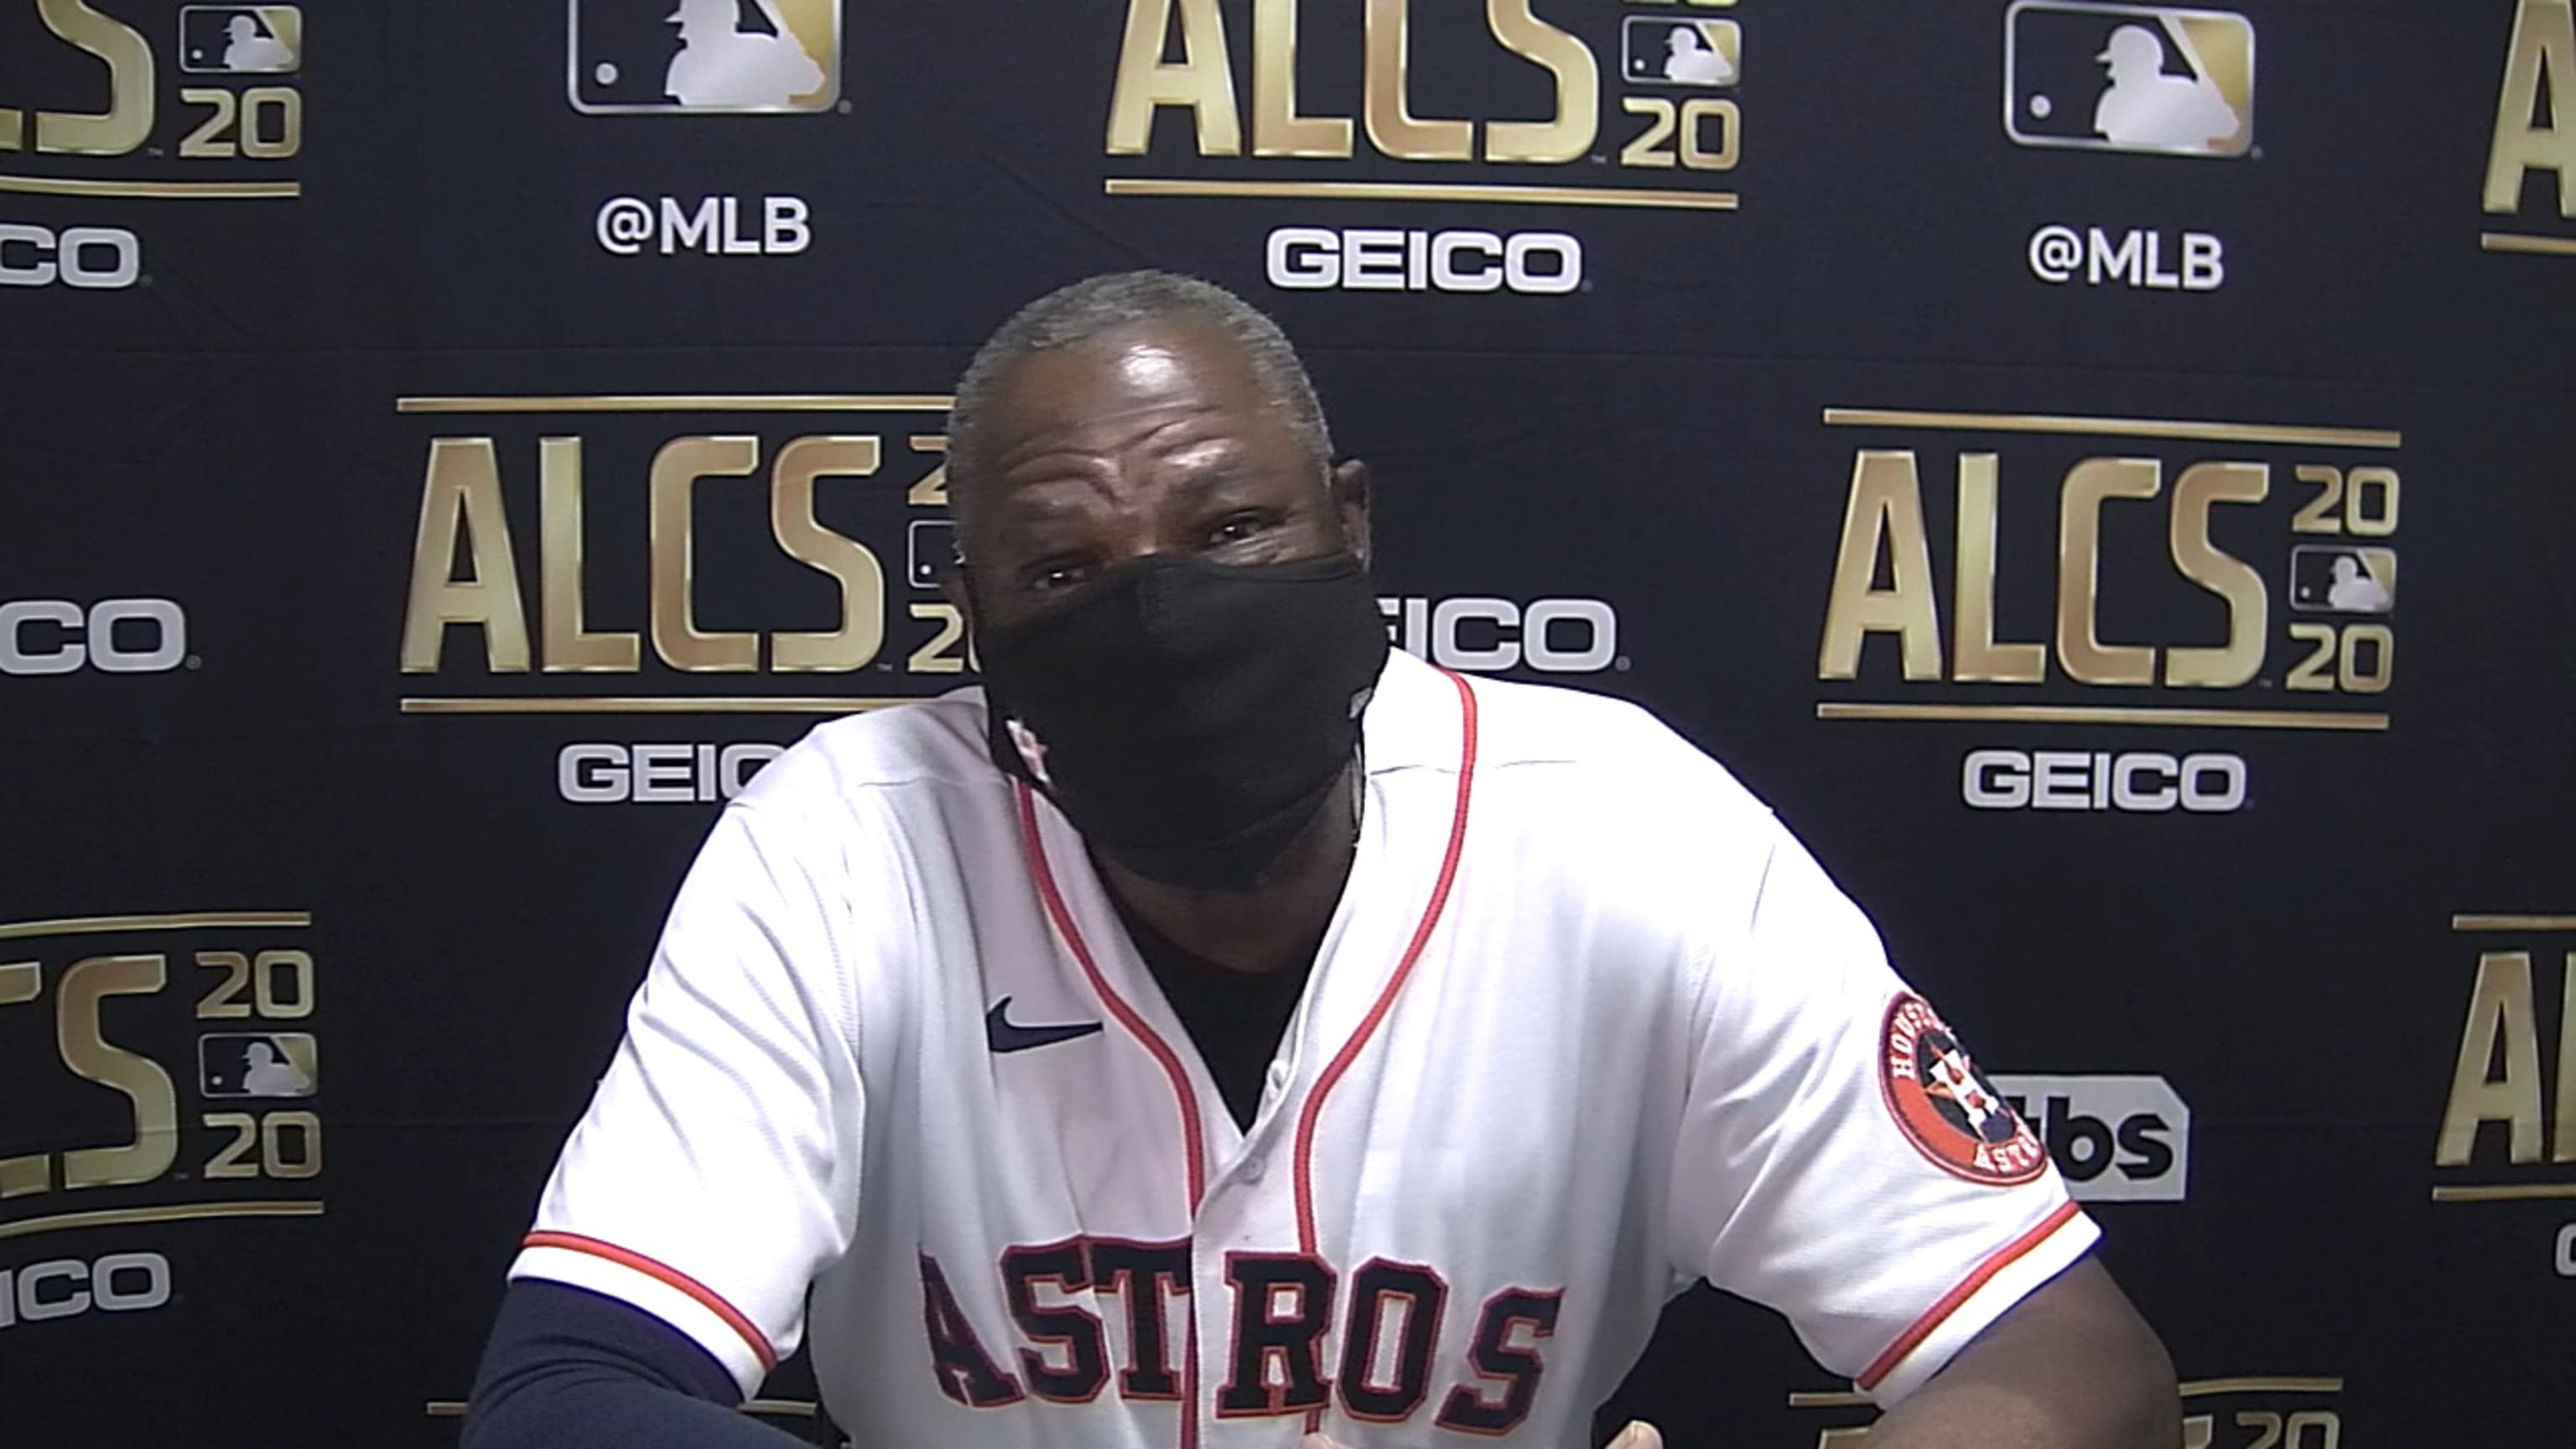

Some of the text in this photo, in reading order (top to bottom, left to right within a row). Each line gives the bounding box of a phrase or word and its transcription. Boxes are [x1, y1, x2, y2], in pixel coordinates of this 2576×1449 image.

[0, 0, 155, 154] S
[1106, 0, 1599, 163] ALCS
[180, 87, 300, 158] 20
[1621, 97, 1740, 169] 20
[597, 197, 810, 253] @MLB
[1267, 227, 1581, 293] GEICO
[2029, 226, 2225, 289] @MLB
[908, 435, 949, 505] 2
[2293, 465, 2400, 535] 20
[402, 435, 886, 673] ALCS
[1819, 449, 2270, 687] ALCS
[2287, 624, 2393, 692] 20
[558, 744, 785, 802] GEIC
[1964, 750, 2247, 811] GEICO
[196, 951, 313, 1018] 20
[204, 1112, 319, 1177] 20
[917, 1234, 1566, 1436] ASTROS
